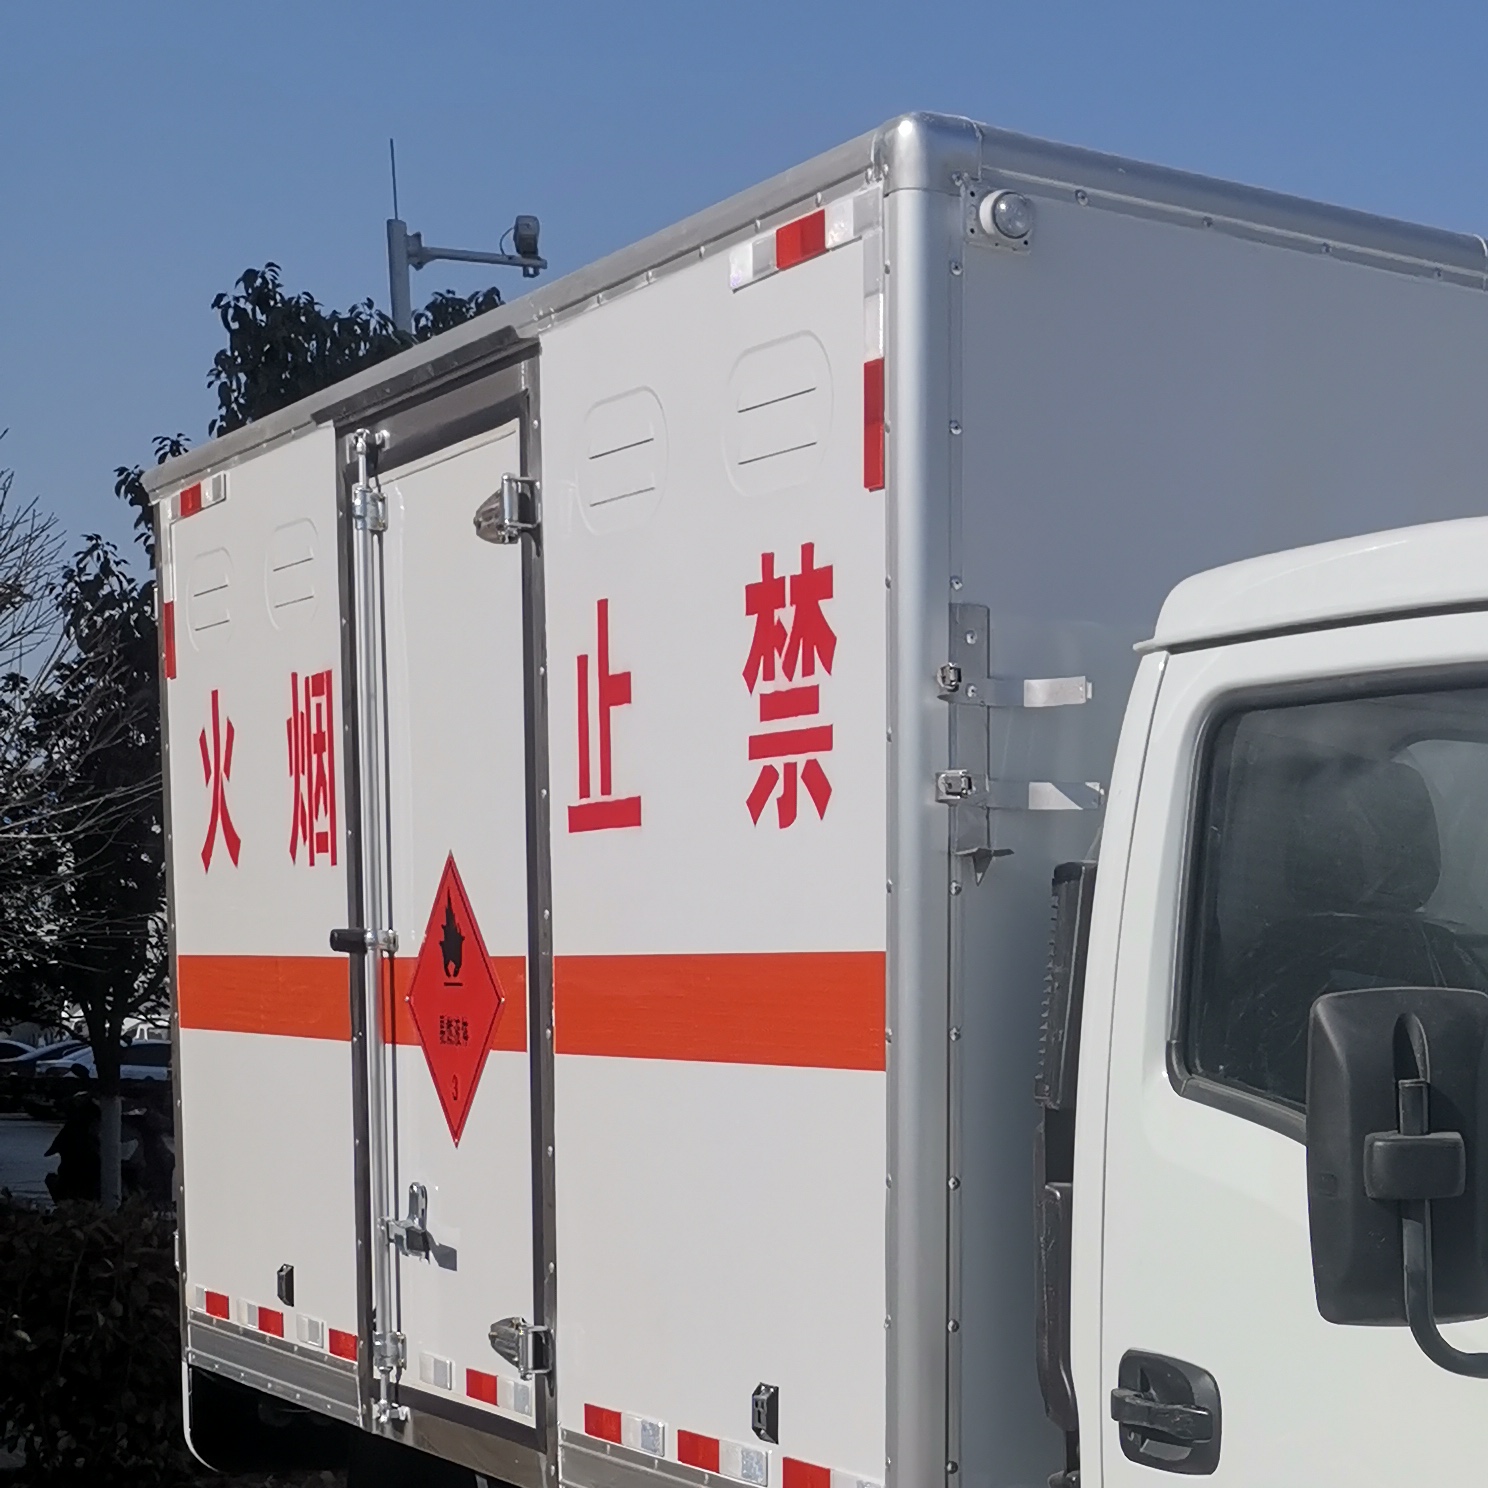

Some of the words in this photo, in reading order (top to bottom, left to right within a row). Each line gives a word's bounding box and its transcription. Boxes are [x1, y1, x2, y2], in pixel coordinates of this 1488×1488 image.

[199, 690, 242, 874] 火
[286, 668, 338, 867] 烟
[568, 598, 642, 833] 止
[743, 543, 837, 829] 禁
